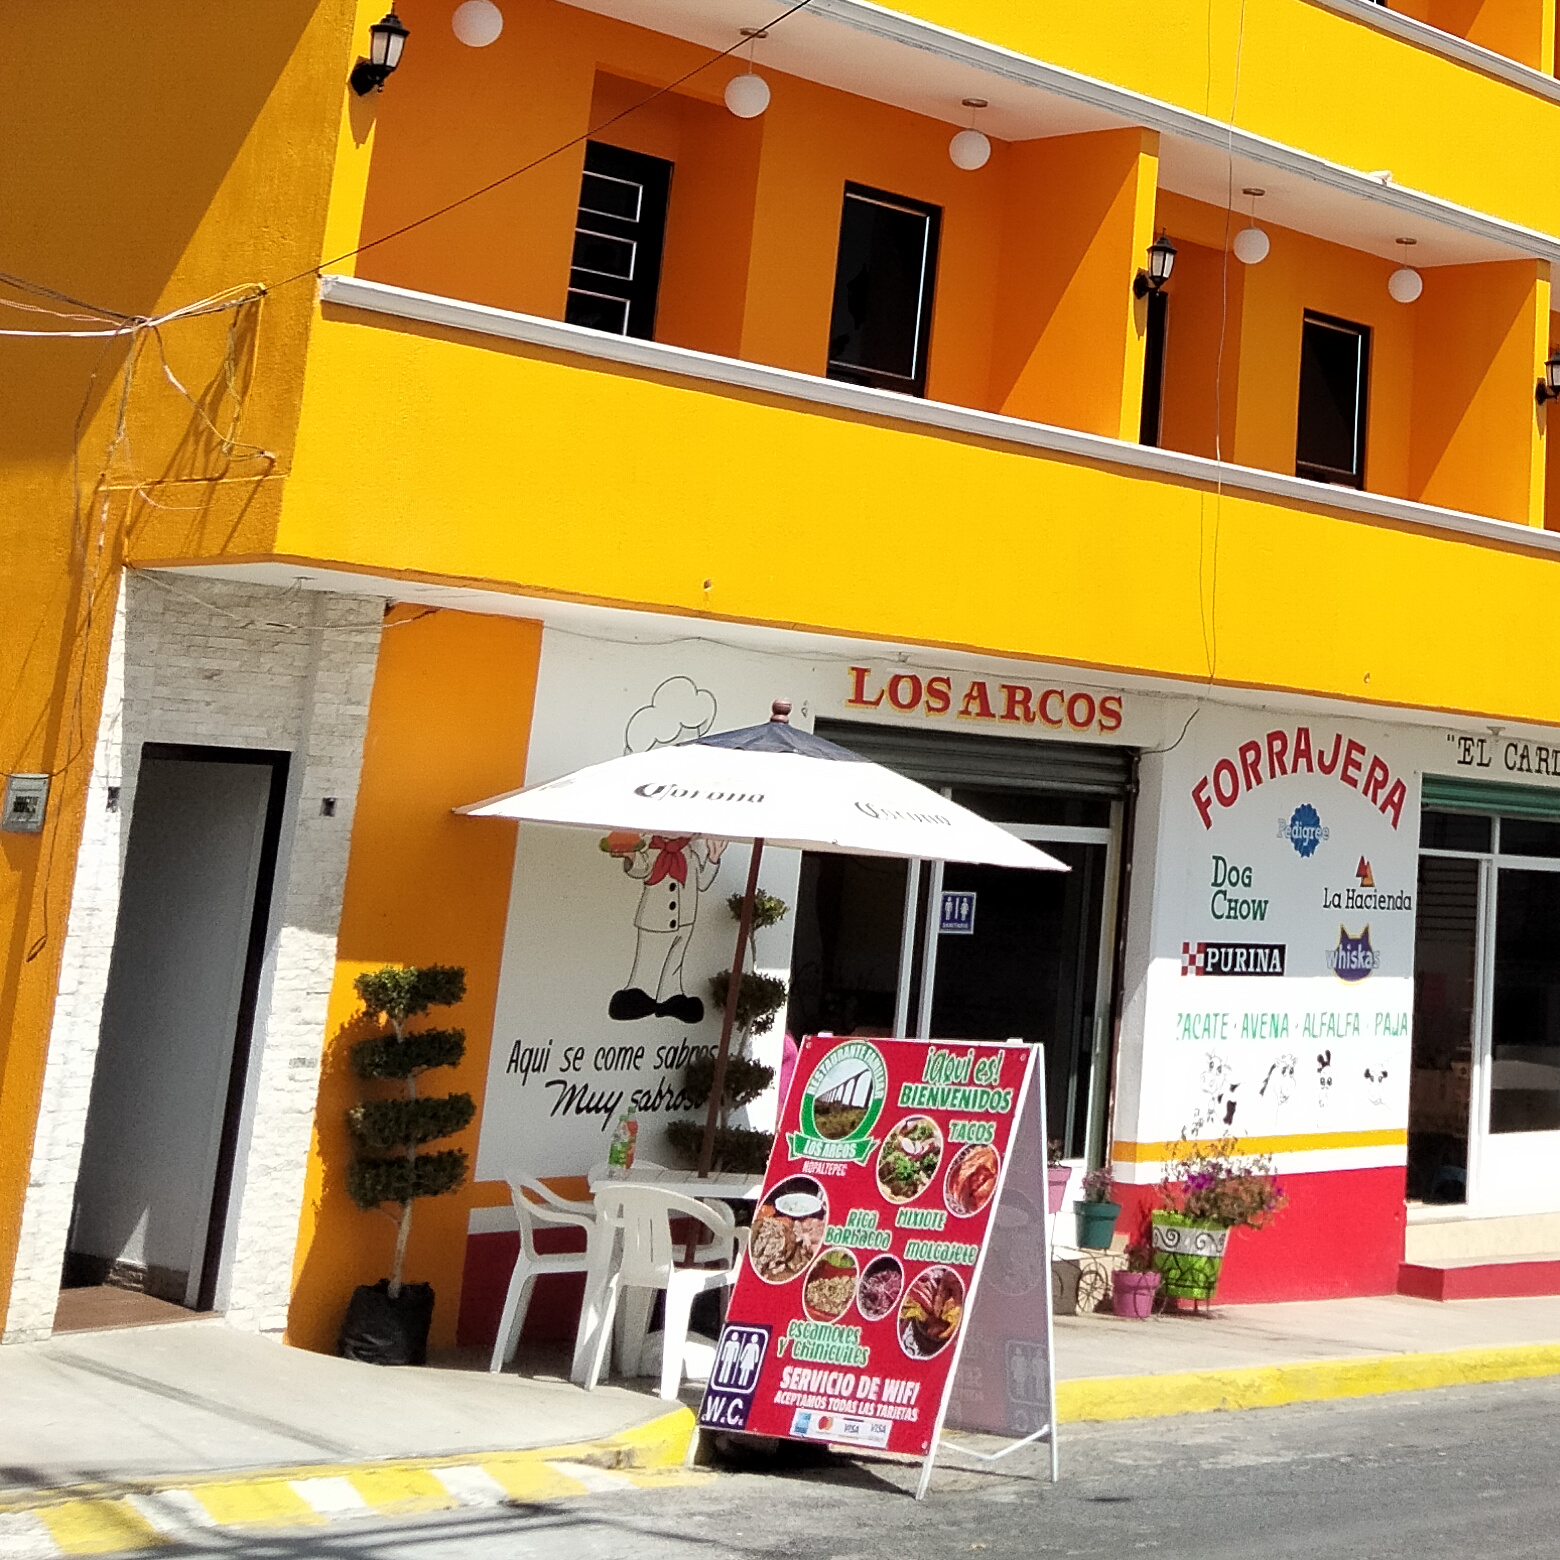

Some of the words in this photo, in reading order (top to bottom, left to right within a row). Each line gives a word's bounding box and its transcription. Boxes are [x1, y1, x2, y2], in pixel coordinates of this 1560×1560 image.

[845, 666, 951, 717] LOS
[957, 680, 1123, 734] ARCOS
[633, 781, 766, 805] Corona
[1191, 727, 1407, 831] FORRAJERA
[1277, 818, 1330, 846] Pedigree
[1323, 888, 1342, 909] La
[1345, 888, 1413, 911] Hacienda
[1205, 947, 1283, 973] PURINA
[1325, 941, 1381, 970] whiskas
[1240, 1012, 1290, 1040] AVENA
[1302, 1011, 1361, 1039] ALFALFA
[1374, 1011, 1408, 1037] PAJA
[505, 1039, 554, 1087] Aqui
[559, 1045, 585, 1073] se
[593, 1044, 646, 1072] come
[545, 1079, 625, 1132] Muy
[898, 1082, 1014, 1114] BIENVENIDOS
[948, 1119, 997, 1145] TACOS
[803, 1139, 823, 1157] LOS
[822, 1142, 857, 1158] ARCOS
[802, 1160, 848, 1177] NOPALTEPEC
[895, 1207, 948, 1231] MIXIOTE
[779, 1364, 856, 1397] SERVICIO
[856, 1375, 881, 1400] DE
[881, 1378, 921, 1406] WIFI
[705, 1395, 745, 1427] W.C.
[773, 1389, 828, 1411] ACEPTAMOS
[827, 1396, 860, 1414] TODAS
[858, 1401, 876, 1417] LAS
[876, 1403, 920, 1422] TARJETAS
[843, 1423, 860, 1434] VISA
[870, 1423, 887, 1434] VISA
